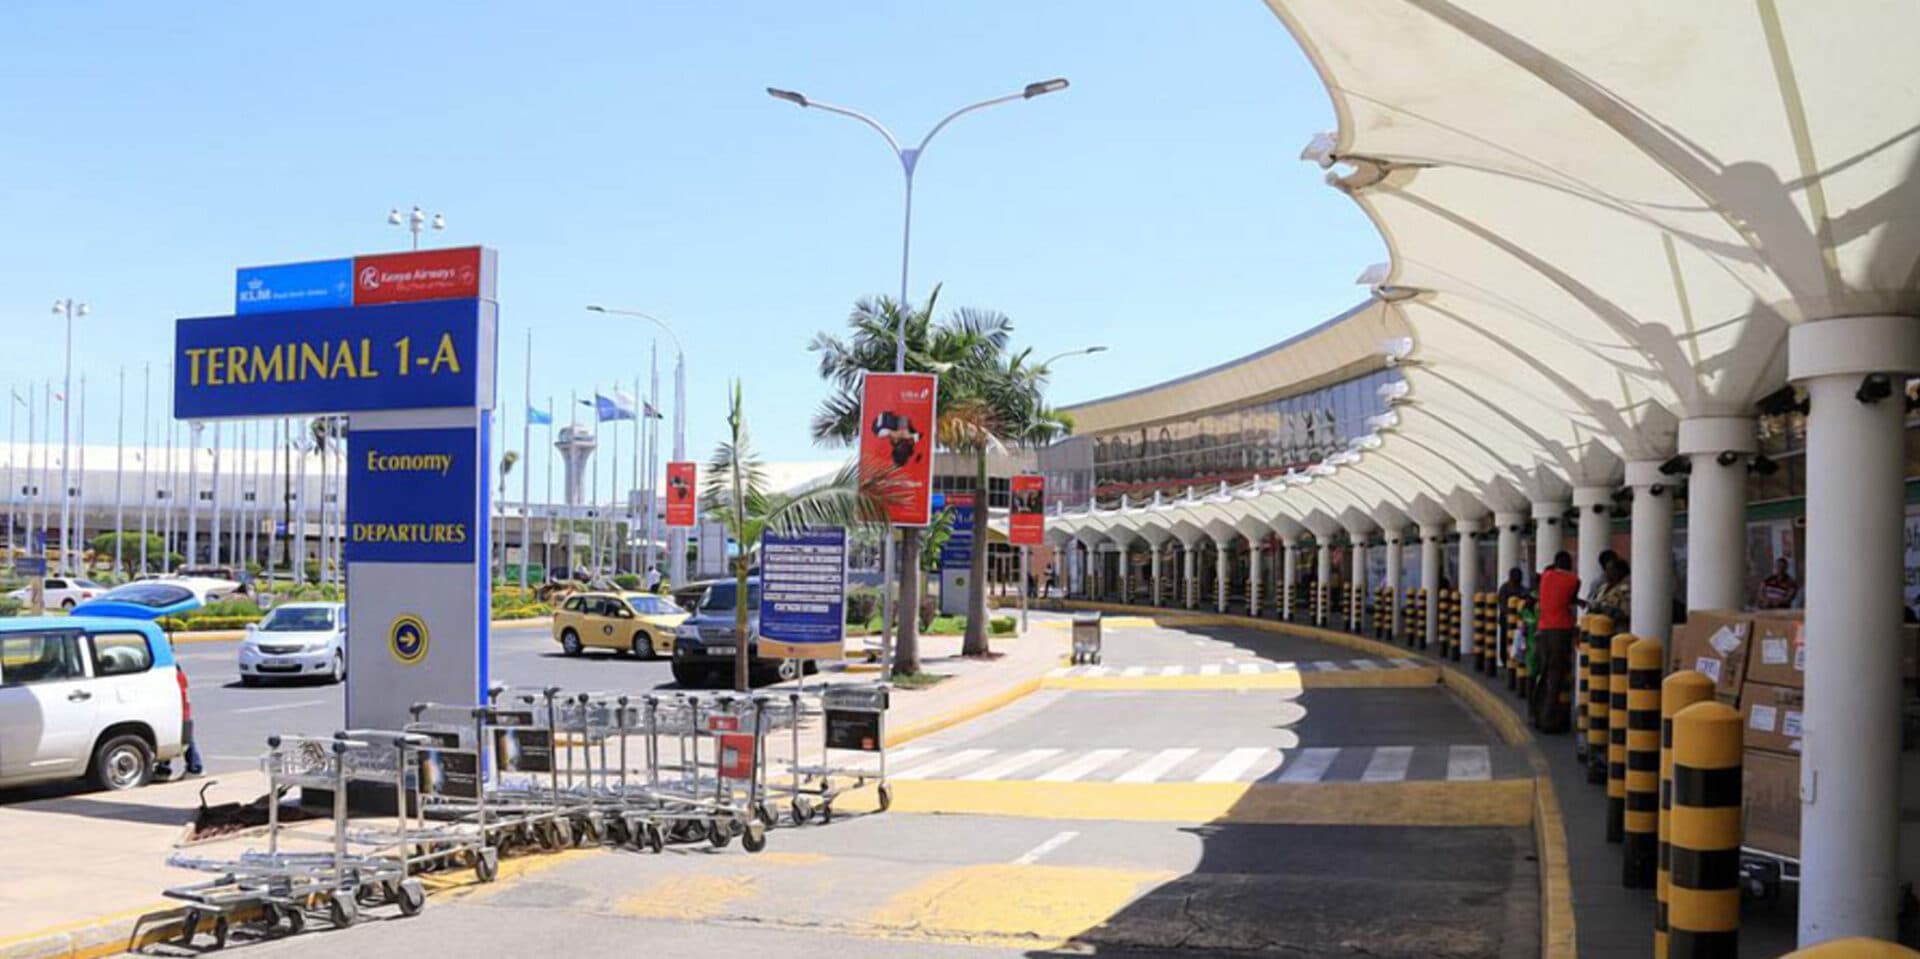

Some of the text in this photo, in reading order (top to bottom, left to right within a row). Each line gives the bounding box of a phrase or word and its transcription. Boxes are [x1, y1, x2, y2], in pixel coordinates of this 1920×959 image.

[381, 267, 456, 284] Kenya Airways
[240, 287, 271, 302] KLM
[184, 332, 460, 387] TERMINAL 1-A
[367, 450, 452, 478] Economy
[352, 523, 467, 544] DEPARTURES
